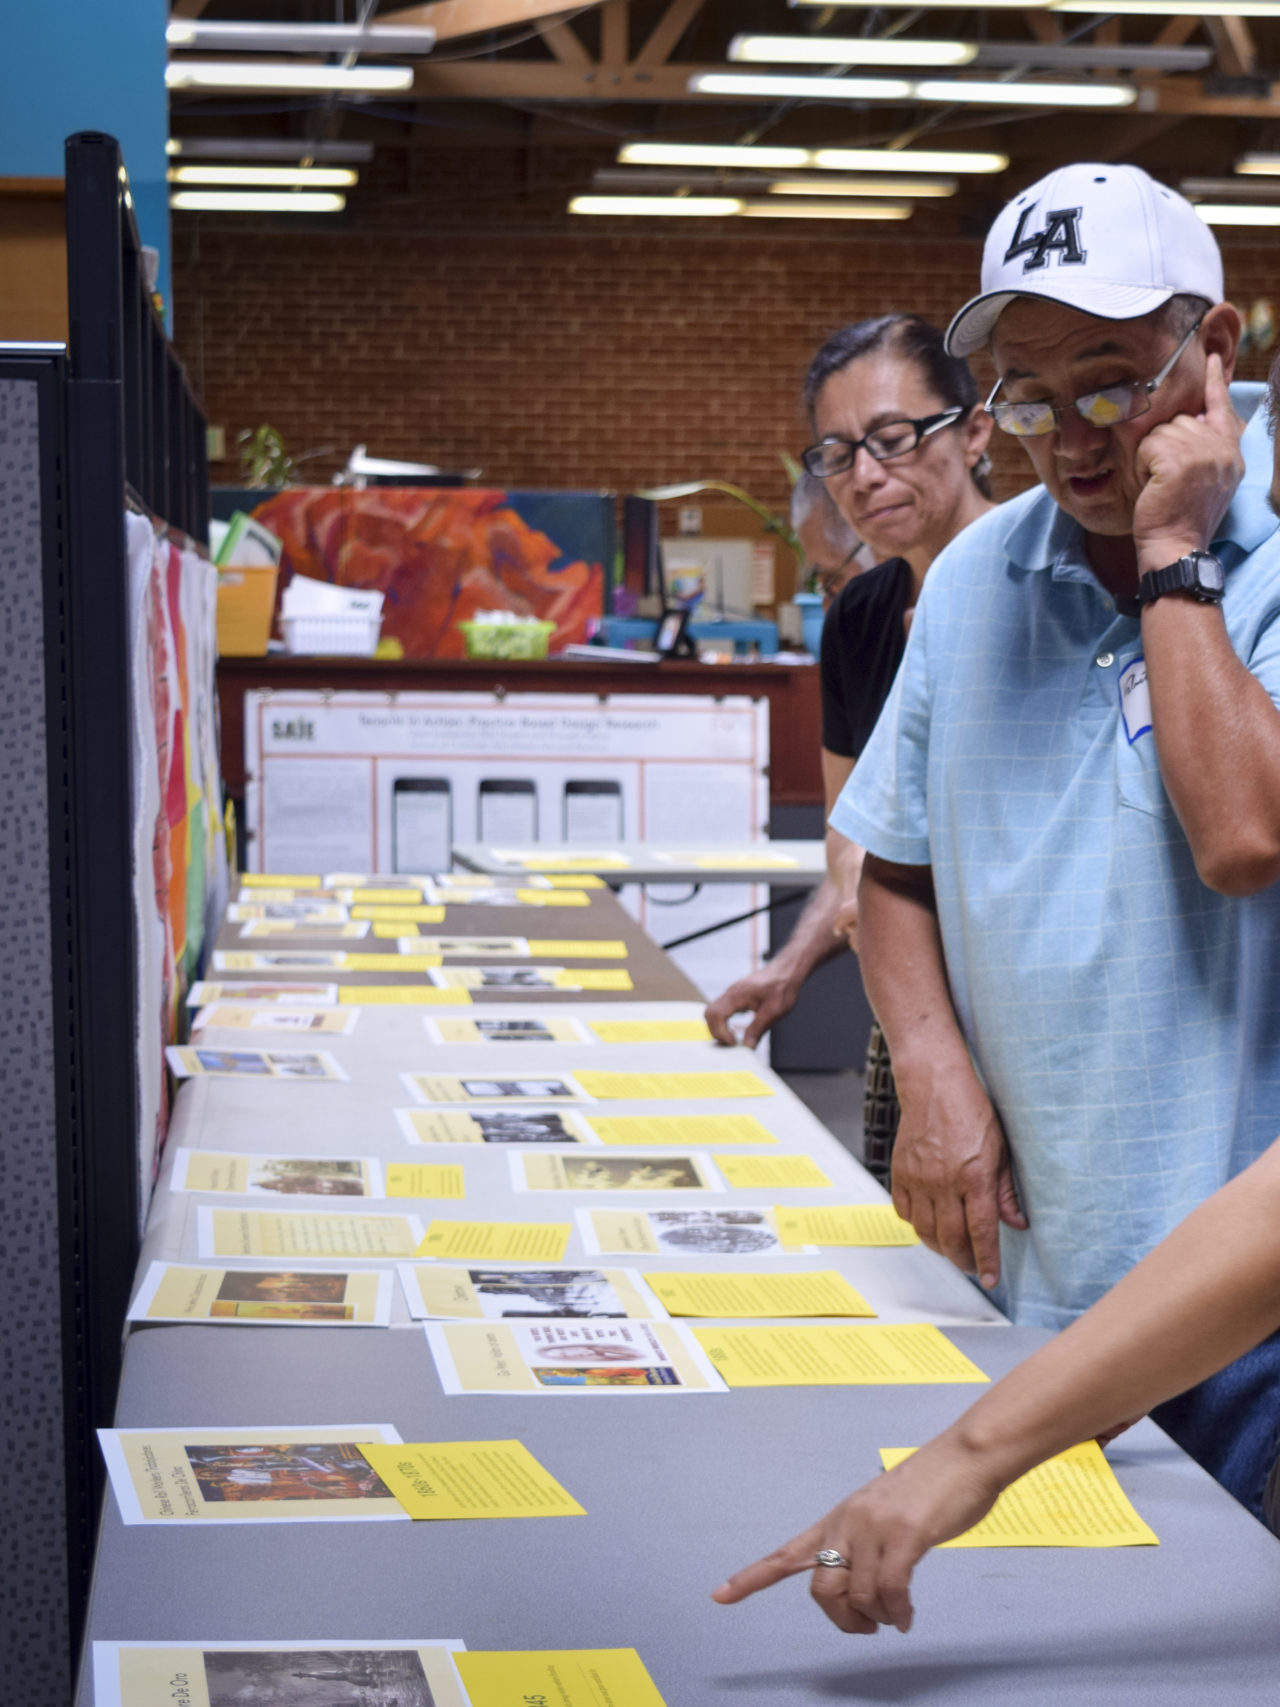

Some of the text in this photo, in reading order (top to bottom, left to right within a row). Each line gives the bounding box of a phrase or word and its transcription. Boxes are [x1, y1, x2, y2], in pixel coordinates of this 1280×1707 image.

[1003, 201, 1088, 274] LA
[169, 1672, 189, 1687] Oro
[171, 1688, 190, 1698] De
